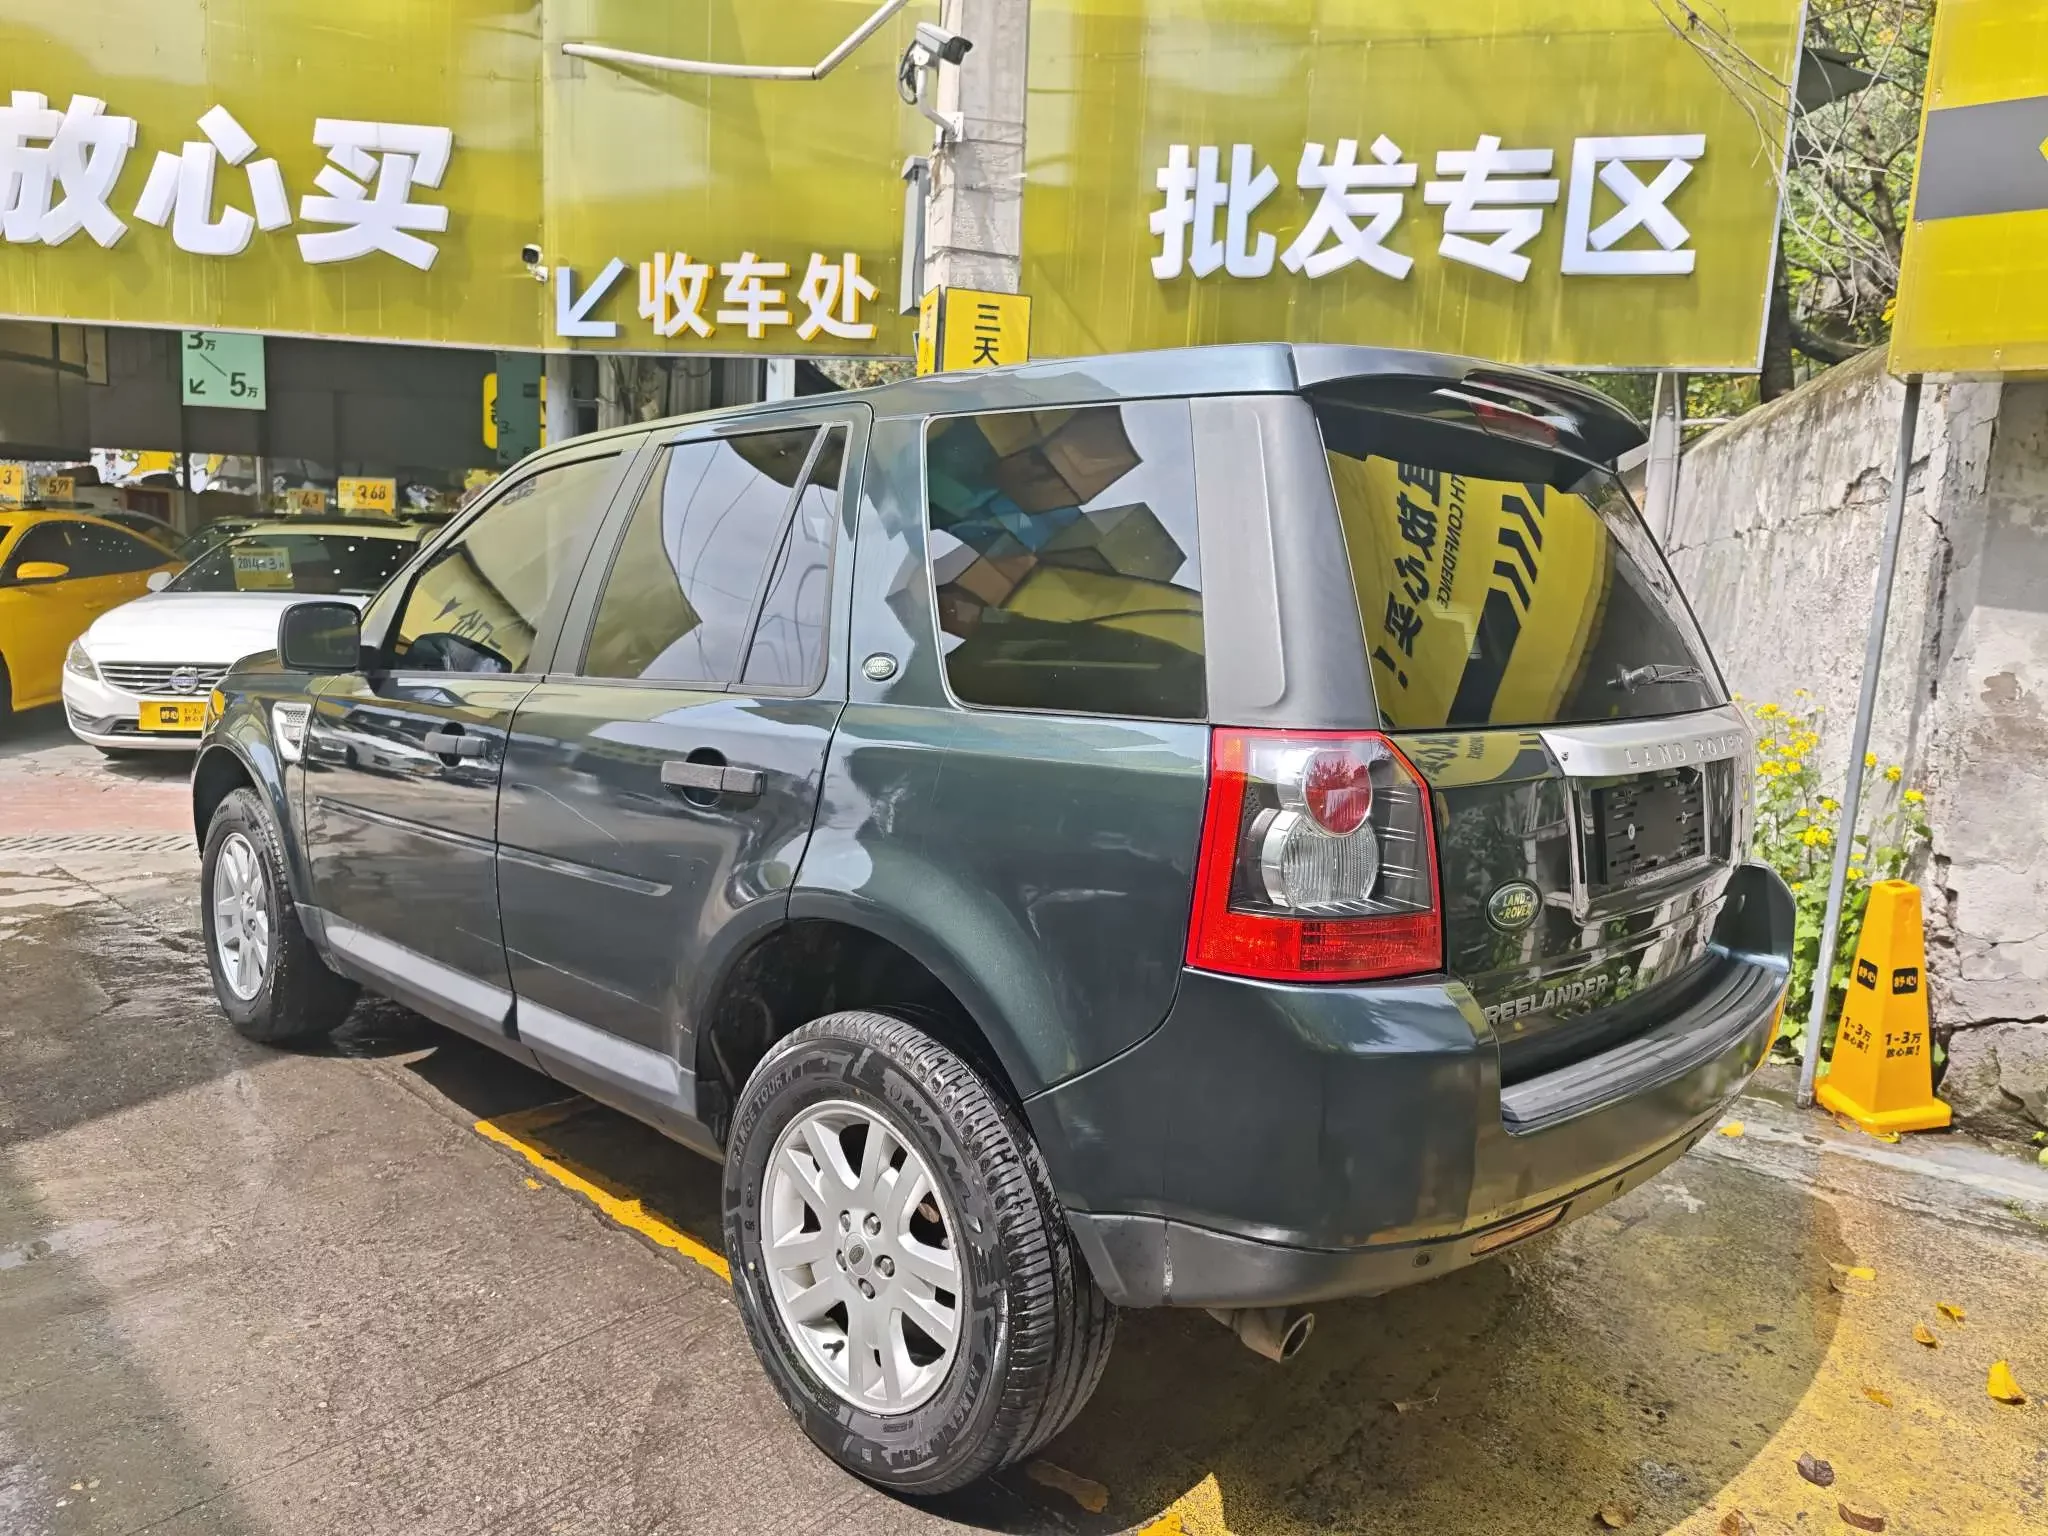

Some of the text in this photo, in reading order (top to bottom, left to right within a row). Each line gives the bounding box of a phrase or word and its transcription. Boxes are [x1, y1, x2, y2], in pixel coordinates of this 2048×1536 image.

[0, 90, 453, 271] 放心买
[1150, 134, 1706, 283] 批发专区
[638, 251, 880, 341] 收车处
[973, 304, 1000, 366] 三天
[230, 372, 259, 399] 5万
[1624, 743, 1687, 769] LAND
[1617, 965, 1632, 985] 2
